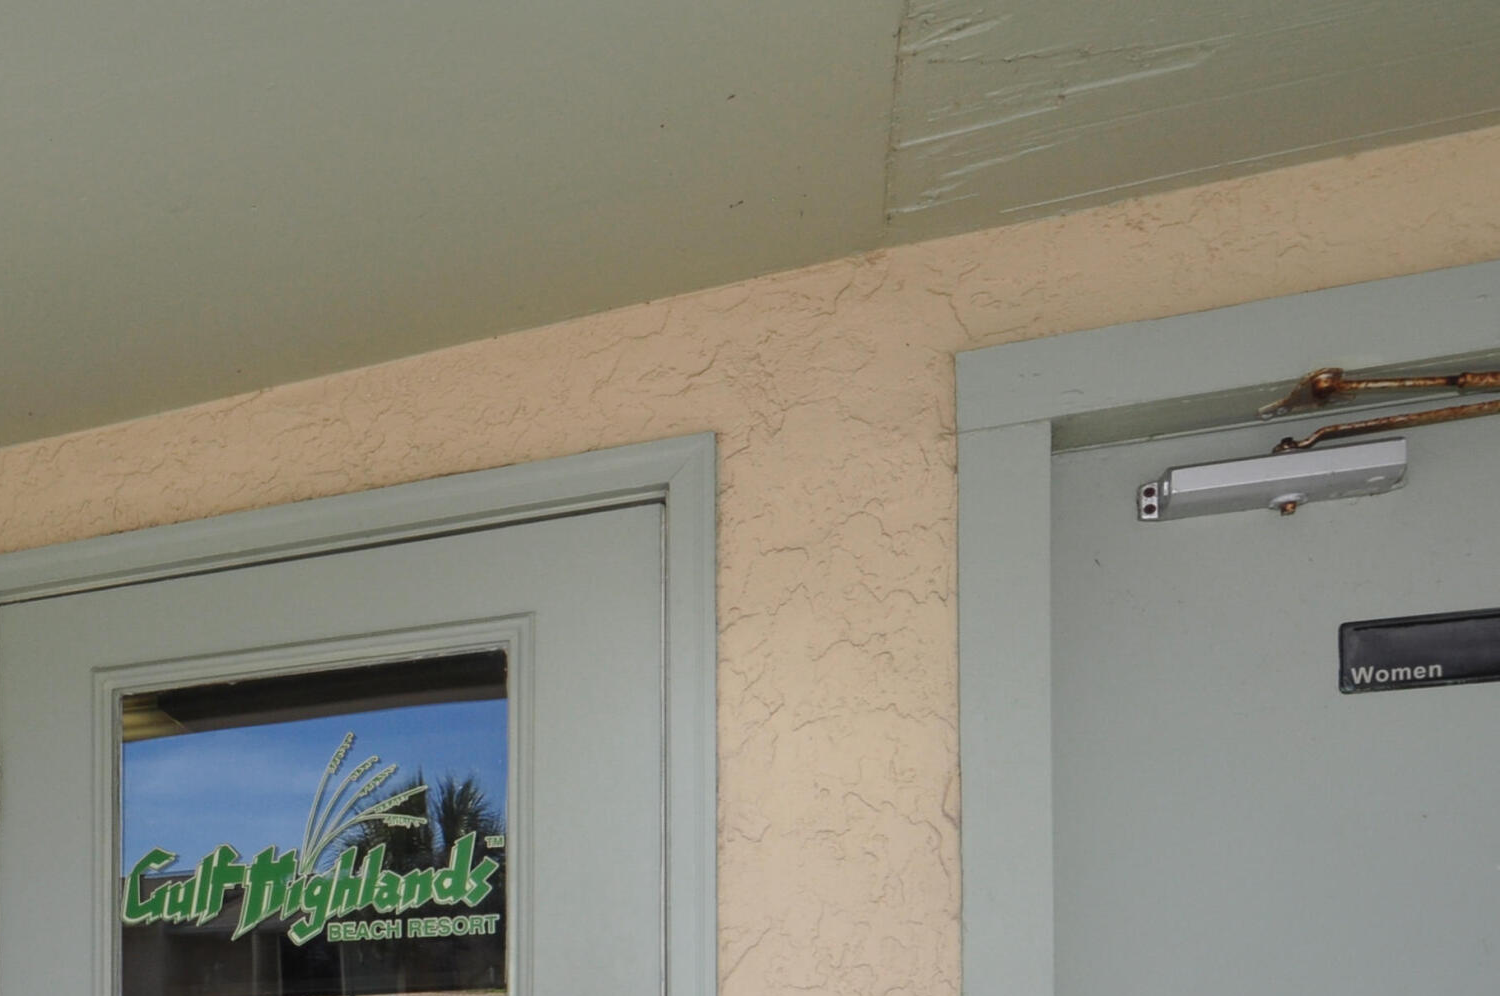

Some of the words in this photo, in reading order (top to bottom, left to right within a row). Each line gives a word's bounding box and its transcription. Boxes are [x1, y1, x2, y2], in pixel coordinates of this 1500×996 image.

[1351, 662, 1443, 685] Women
[122, 843, 248, 926] Gulf
[231, 831, 499, 946] Highlands
[327, 919, 401, 942] BEACH
[407, 914, 500, 938] RESORT
